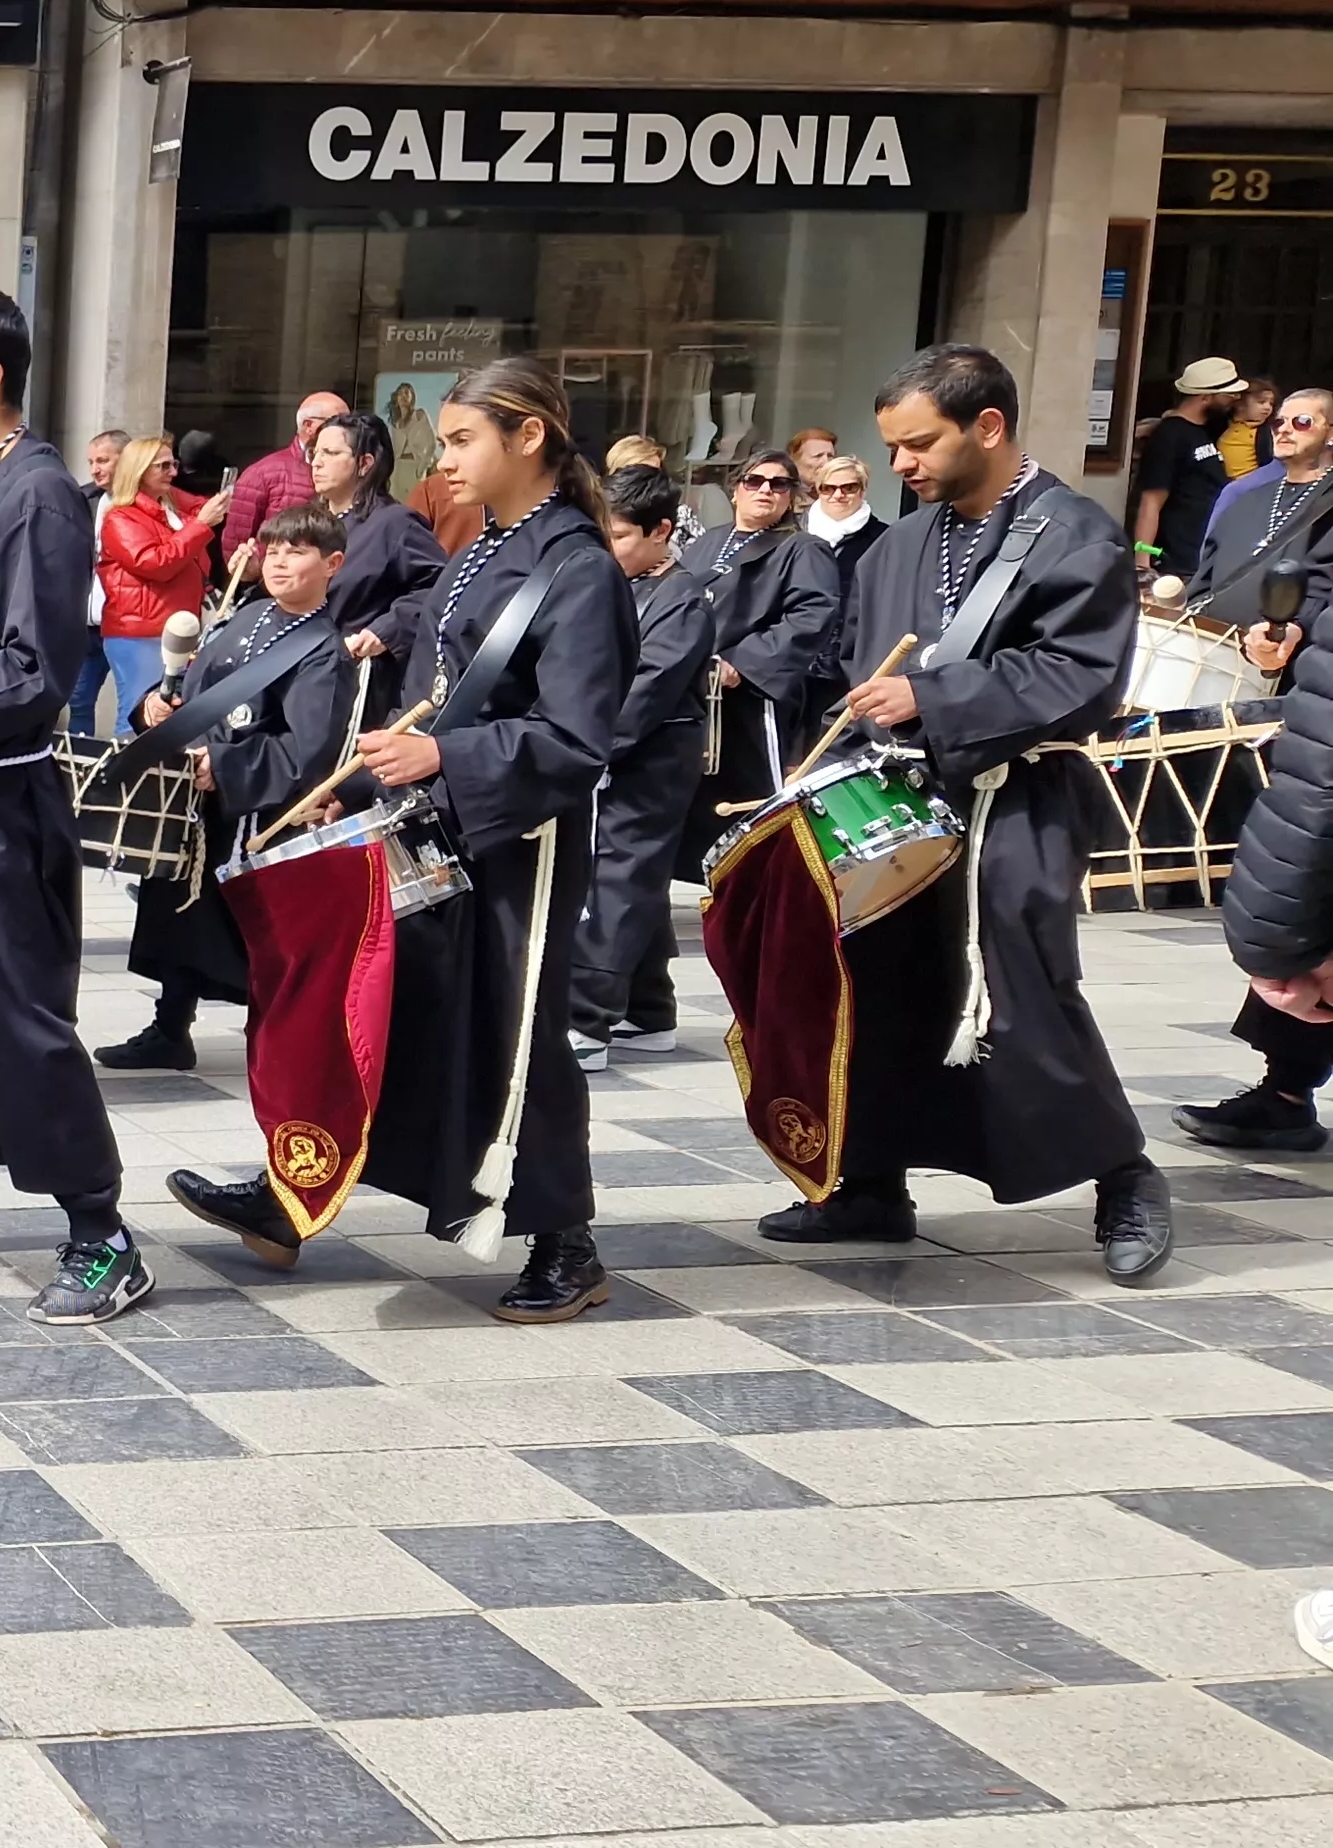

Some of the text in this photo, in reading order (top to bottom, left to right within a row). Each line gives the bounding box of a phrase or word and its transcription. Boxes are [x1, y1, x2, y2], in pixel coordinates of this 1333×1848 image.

[307, 105, 912, 187] CALZEDONIA
[1210, 168, 1272, 202] 23
[386, 324, 437, 341] Fresh
[412, 348, 465, 366] pants
